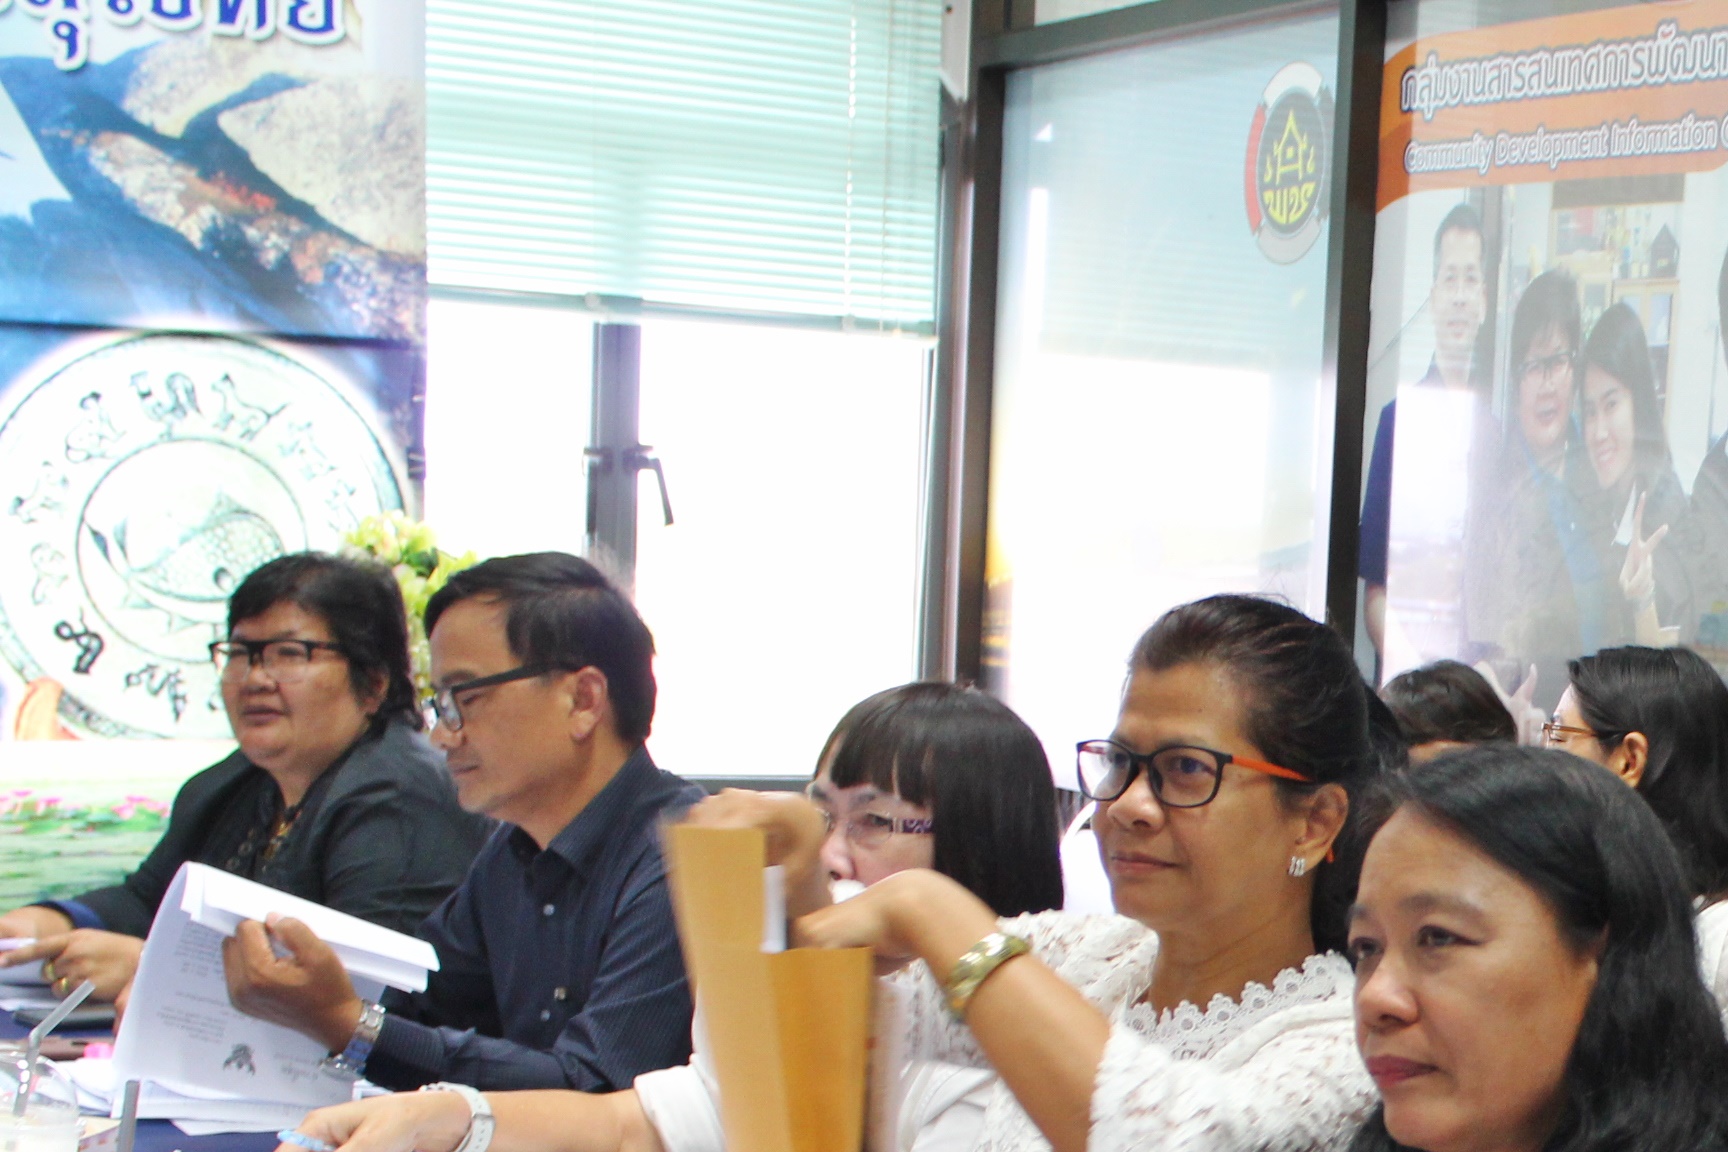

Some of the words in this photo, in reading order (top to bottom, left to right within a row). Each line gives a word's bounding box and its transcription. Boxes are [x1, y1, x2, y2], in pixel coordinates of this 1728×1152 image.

[1403, 131, 1494, 176] Community
[1495, 123, 1610, 170] Development
[1611, 112, 1719, 157] Information
